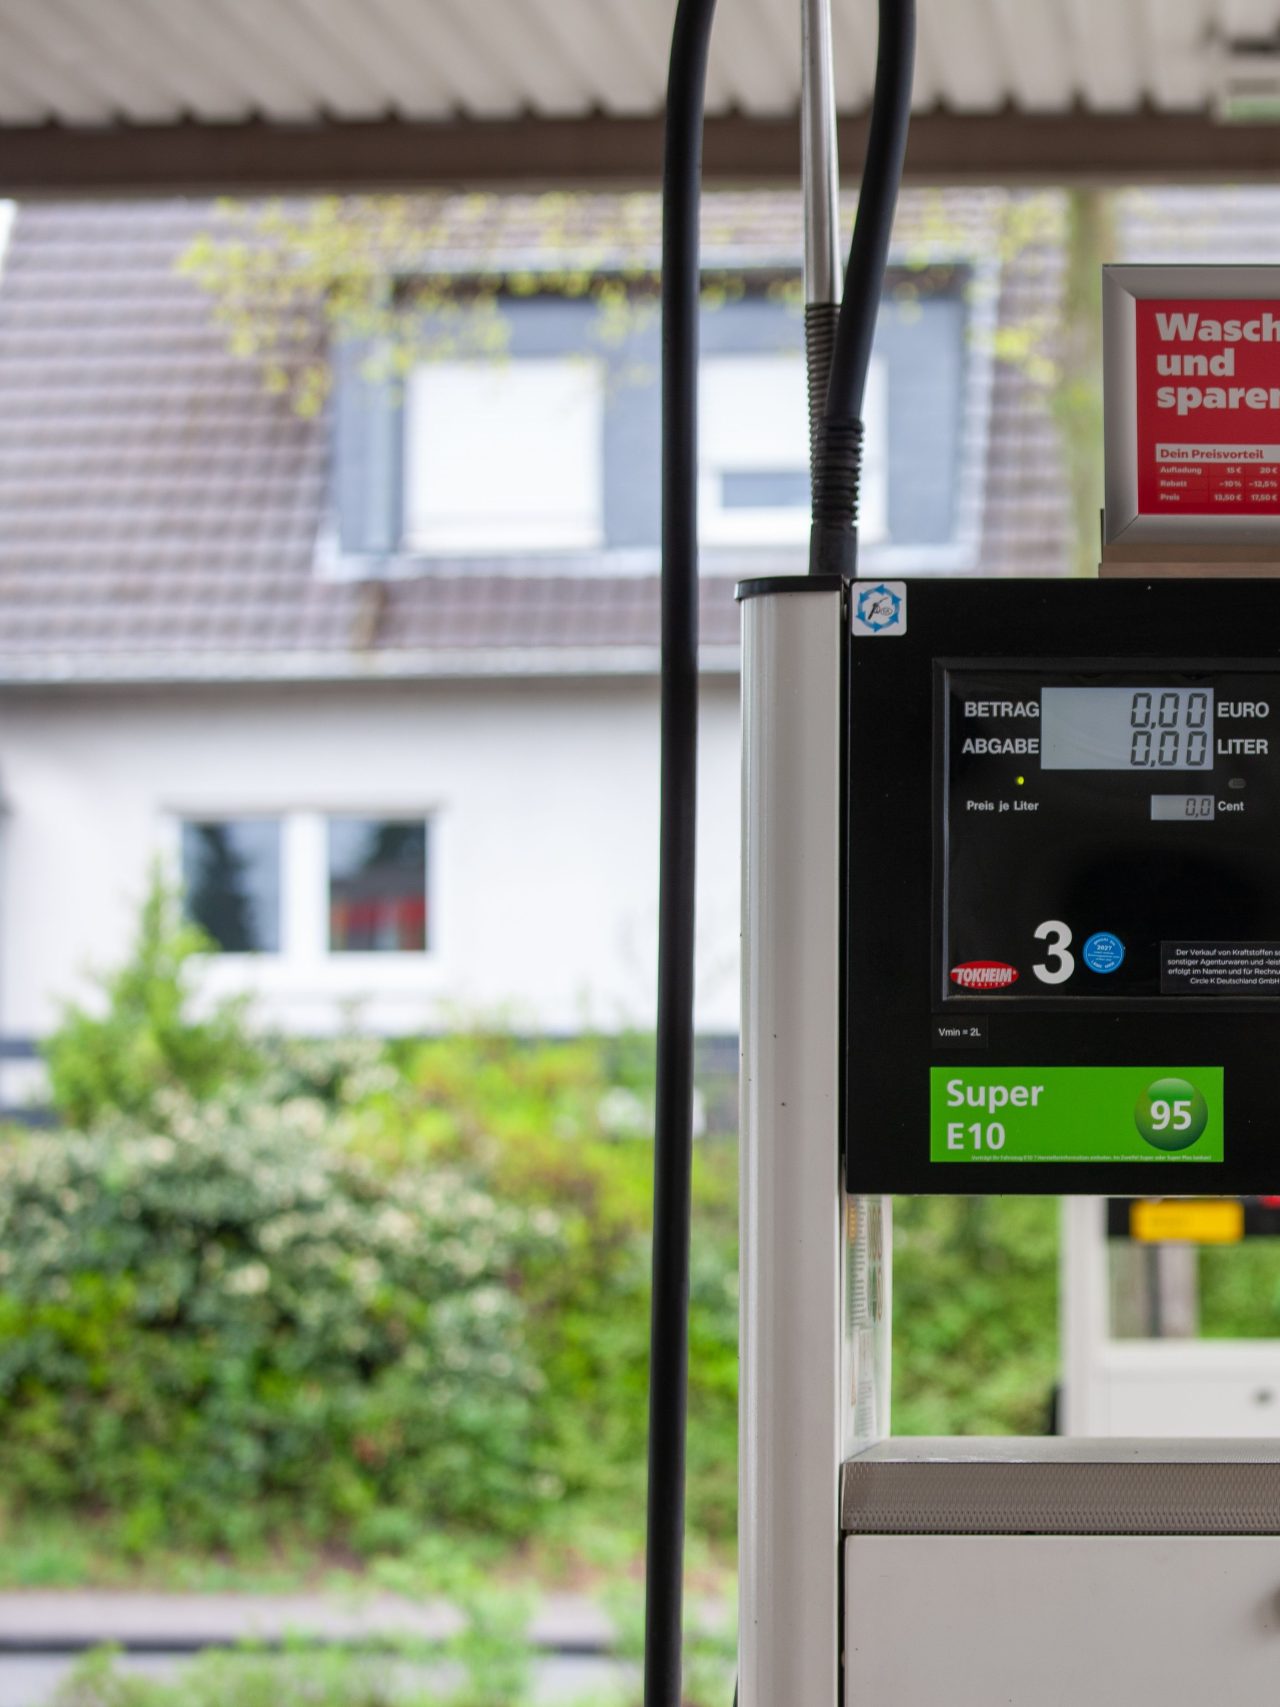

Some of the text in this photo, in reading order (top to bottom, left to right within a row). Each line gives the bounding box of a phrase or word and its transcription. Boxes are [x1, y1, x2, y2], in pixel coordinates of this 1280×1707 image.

[1156, 348, 1235, 377] und
[1160, 449, 1264, 460] Dein Preisvorteil
[1160, 466, 1202, 475] Aufladung
[964, 702, 1040, 718] BETRAG
[1130, 693, 1207, 729] 0,00
[1217, 702, 1269, 718] EURO
[962, 739, 1039, 754] ABGABE
[1130, 731, 1207, 767] 0,00
[1217, 739, 1268, 754] LITER
[966, 801, 1039, 813] Preis je Liter
[1185, 798, 1211, 817] 0,0
[1218, 801, 1244, 811] Cent
[1032, 920, 1075, 984] 3
[951, 968, 1012, 984] TOKHEIM
[938, 1028, 960, 1036] Vmin
[970, 1028, 981, 1036] 2L
[947, 1079, 1044, 1113] Super
[1150, 1100, 1192, 1131] 95
[947, 1123, 1005, 1150] E10
